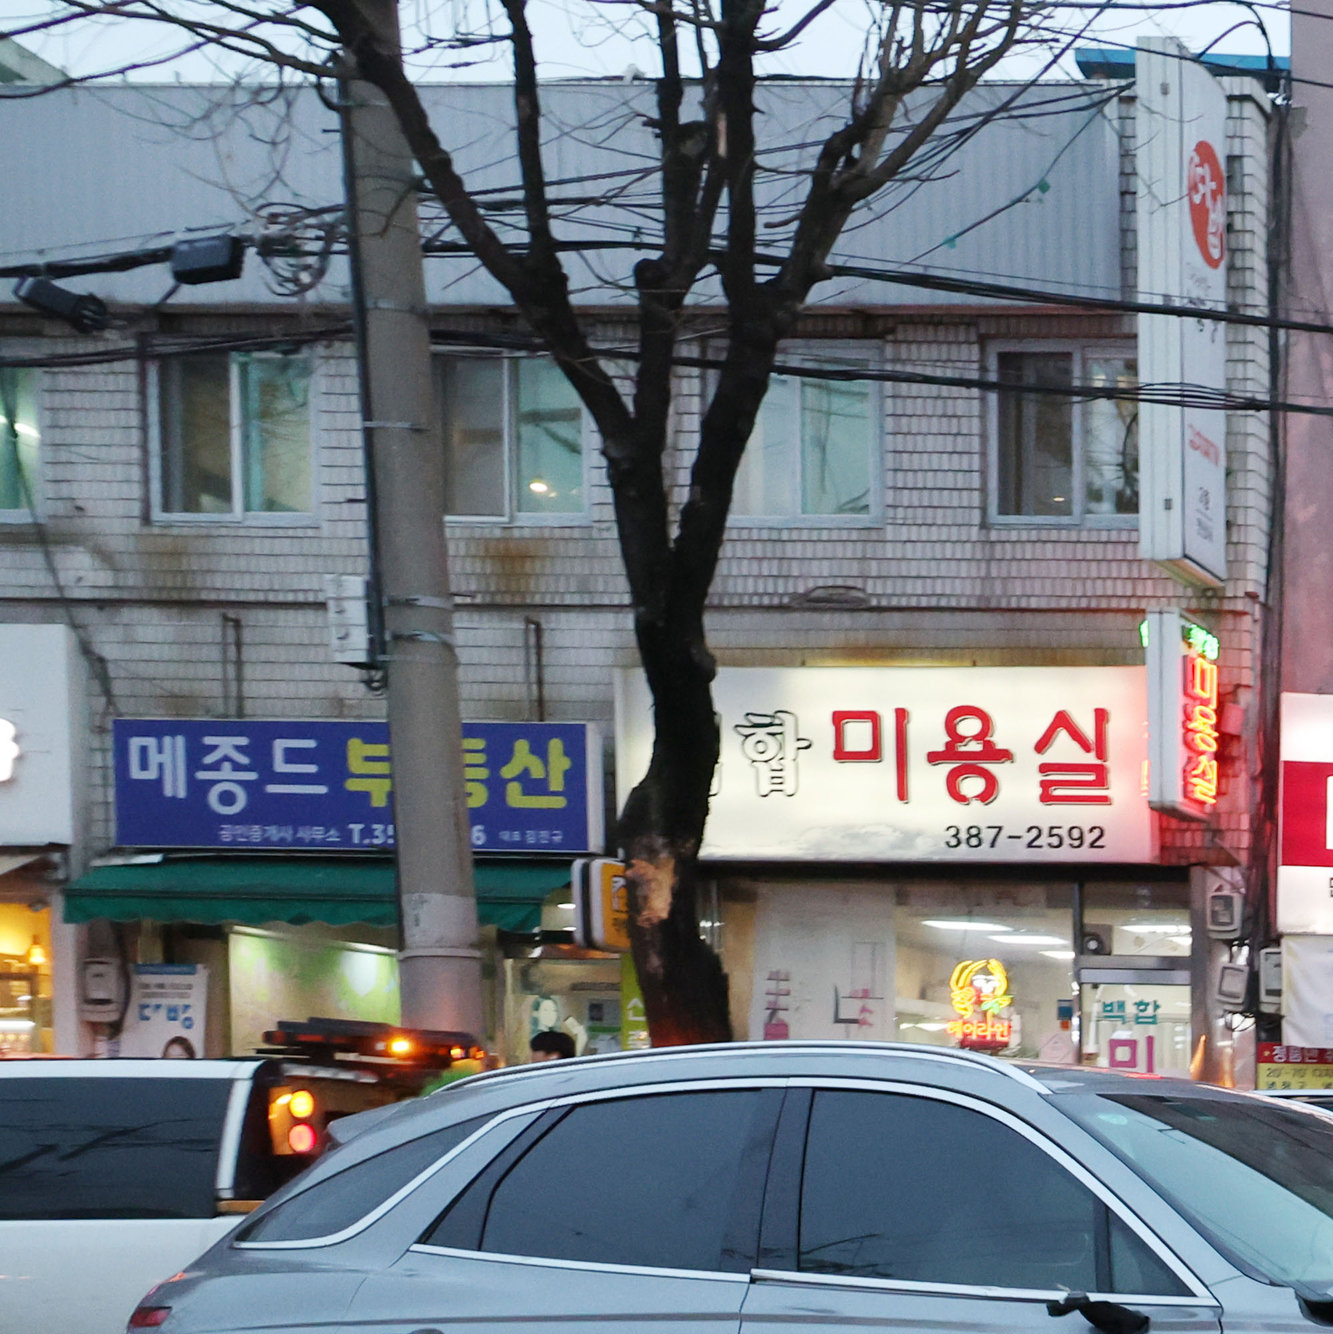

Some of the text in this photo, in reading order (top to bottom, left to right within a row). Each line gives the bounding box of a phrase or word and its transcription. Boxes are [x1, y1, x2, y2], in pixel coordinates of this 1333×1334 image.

[713, 704, 1114, 806] 합 미용실
[1183, 655, 1219, 804] 미용실
[127, 734, 329, 816] 메종드
[944, 824, 1107, 851] 387-2592
[1102, 1000, 1160, 1025] 백합
[1108, 1034, 1155, 1074] 미
